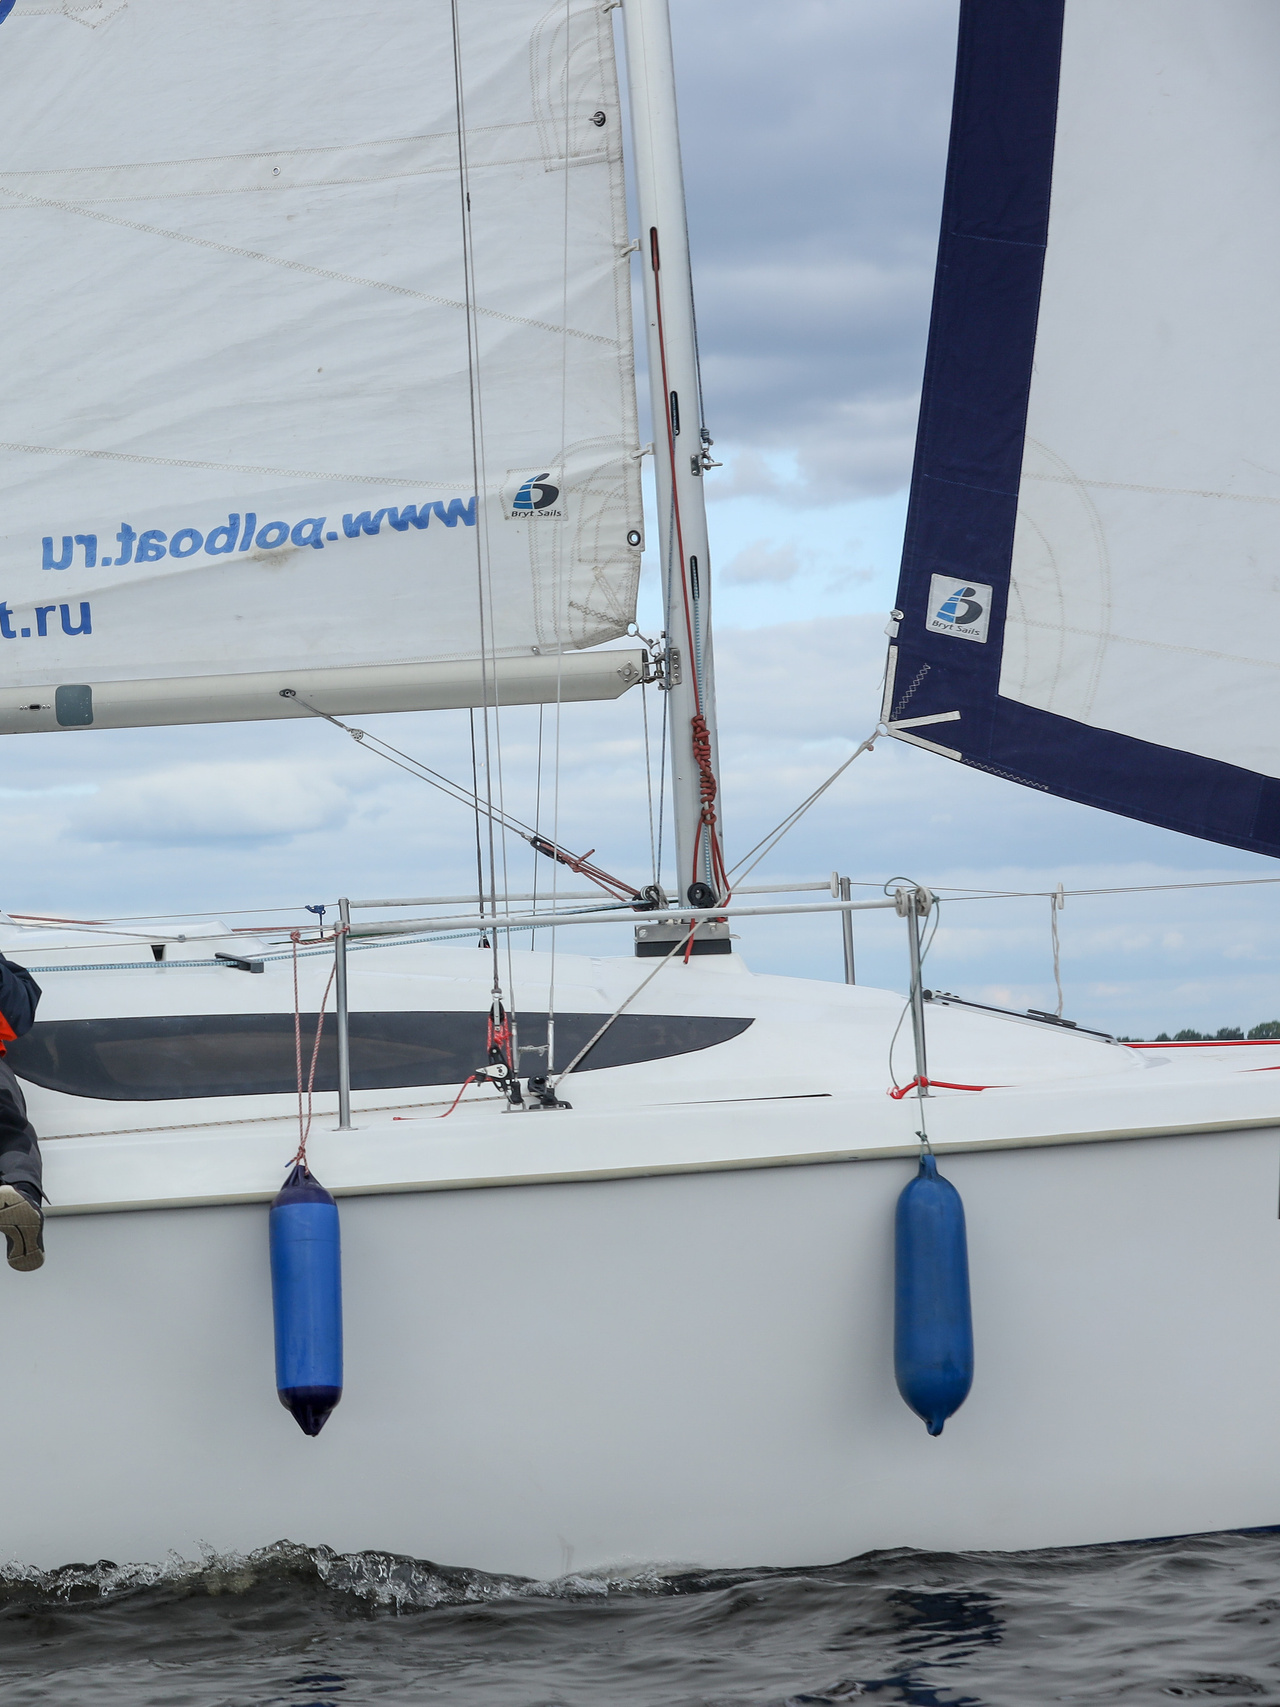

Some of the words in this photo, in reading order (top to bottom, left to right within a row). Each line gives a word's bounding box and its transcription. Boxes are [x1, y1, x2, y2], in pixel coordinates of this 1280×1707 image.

[511, 510, 534, 518] Bryt
[537, 509, 562, 517] Sails
[932, 620, 954, 631] Bryt
[956, 625, 981, 636] Sails
